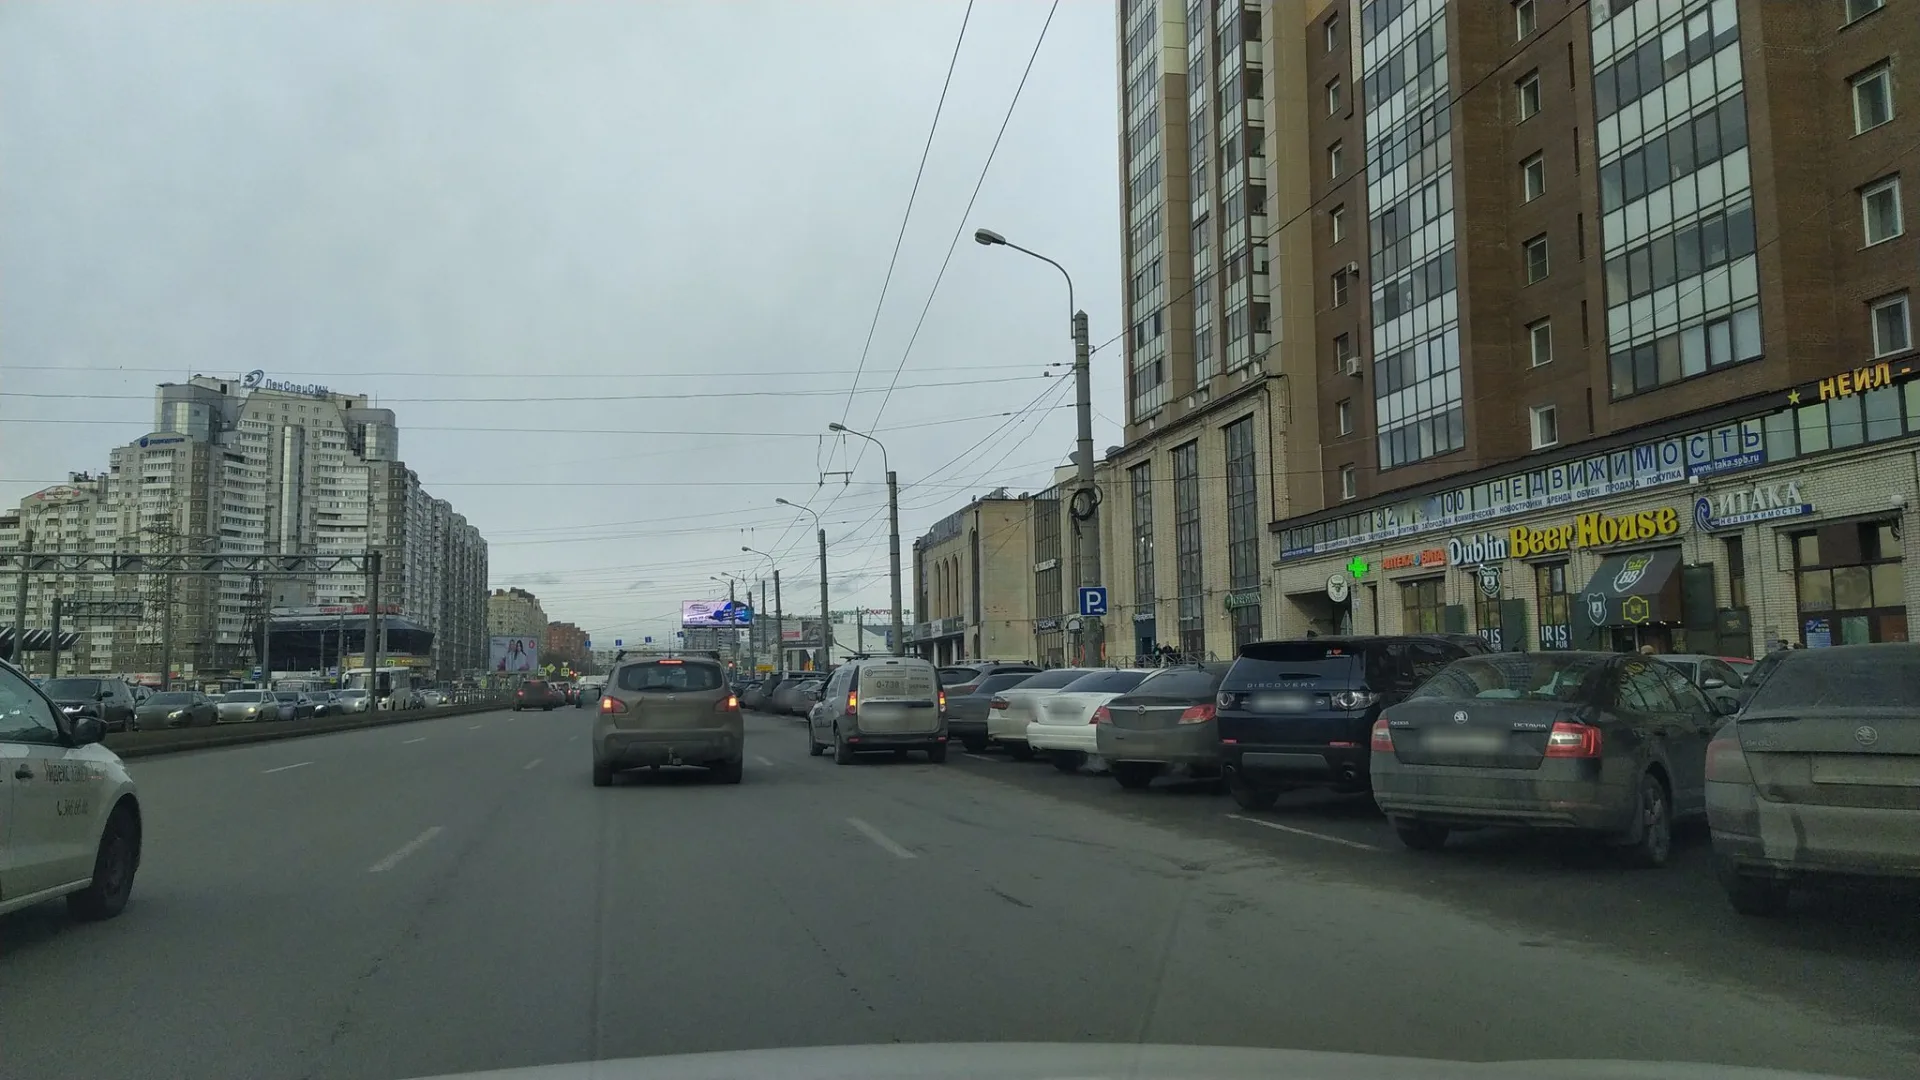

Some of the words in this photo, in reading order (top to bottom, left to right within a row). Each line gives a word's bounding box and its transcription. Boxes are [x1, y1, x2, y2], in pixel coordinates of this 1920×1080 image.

[1494, 425, 1759, 501] НЕДВИЖИМОСТЬ
[1692, 453, 1759, 474] www.taka.spb.ru
[1422, 517, 1452, 530] ЗАГОРОДНАЯ
[1455, 509, 1496, 525] КОММЕРЧЕСКАЯ
[1500, 500, 1543, 514] НОВОСТРОЙКИ
[1547, 493, 1571, 505] АРЕНДА
[1577, 487, 1600, 498] ОБМЕН
[1606, 480, 1640, 493] ПРОДАЖА
[1647, 470, 1682, 485] ПОКУПКА
[1719, 481, 1802, 517] ИТАКА
[1720, 507, 1801, 526] недвижимость
[1448, 533, 1506, 566] Dublin
[1509, 524, 1573, 559] Beer
[1576, 506, 1677, 549] House
[1086, 591, 1101, 613] P
[1541, 625, 1572, 641] IRIS
